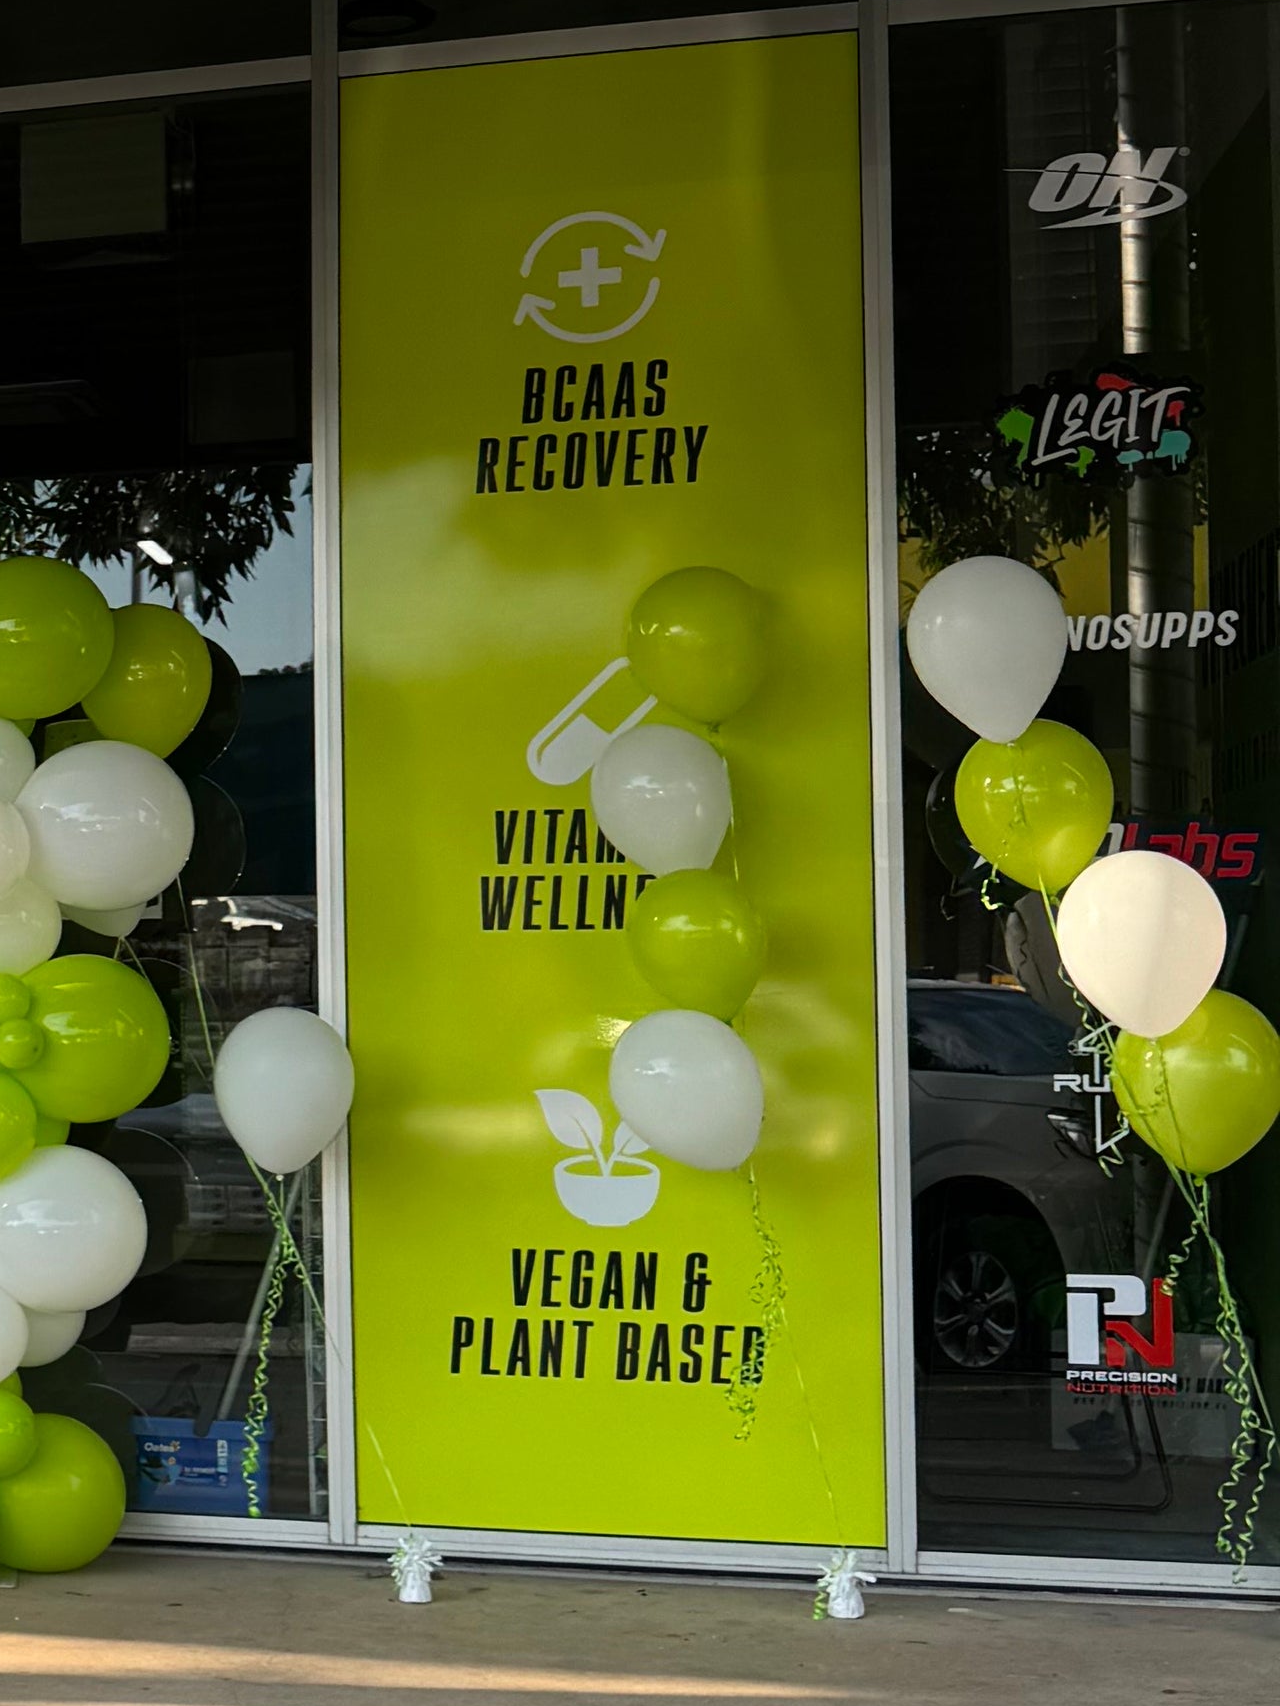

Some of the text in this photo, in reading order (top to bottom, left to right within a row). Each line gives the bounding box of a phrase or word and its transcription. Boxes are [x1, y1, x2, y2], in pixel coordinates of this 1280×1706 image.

[521, 358, 669, 425] BCAAS
[475, 424, 710, 495] RECOVERY
[1031, 386, 1192, 466] LEGIT
[511, 1248, 712, 1314] VEGAN &
[449, 1315, 766, 1387] PLANT BASED
[1066, 1369, 1178, 1384] PRECISION
[1066, 1382, 1177, 1397] NUTRITION
